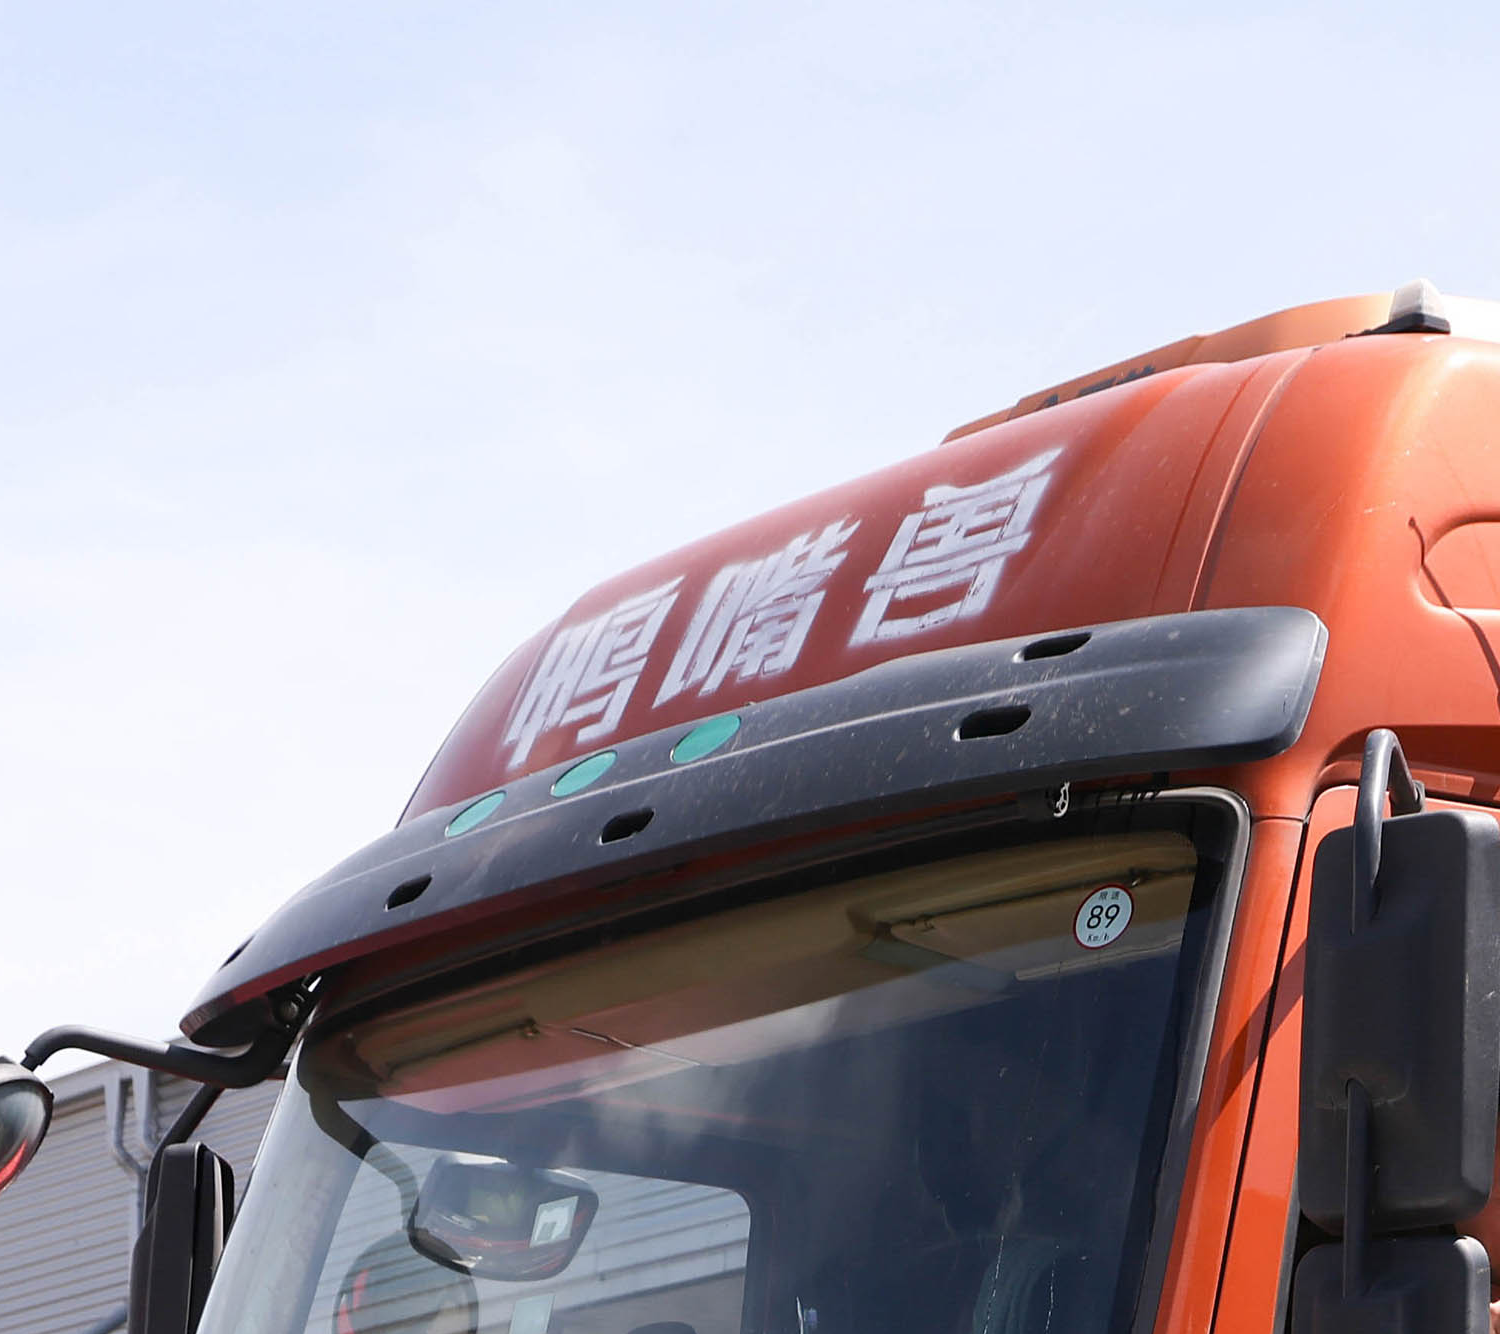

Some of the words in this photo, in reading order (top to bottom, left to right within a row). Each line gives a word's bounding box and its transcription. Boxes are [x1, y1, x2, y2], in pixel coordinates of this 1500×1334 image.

[504, 447, 1064, 771] 鸭嘴兽
[1086, 903, 1120, 929] 89
